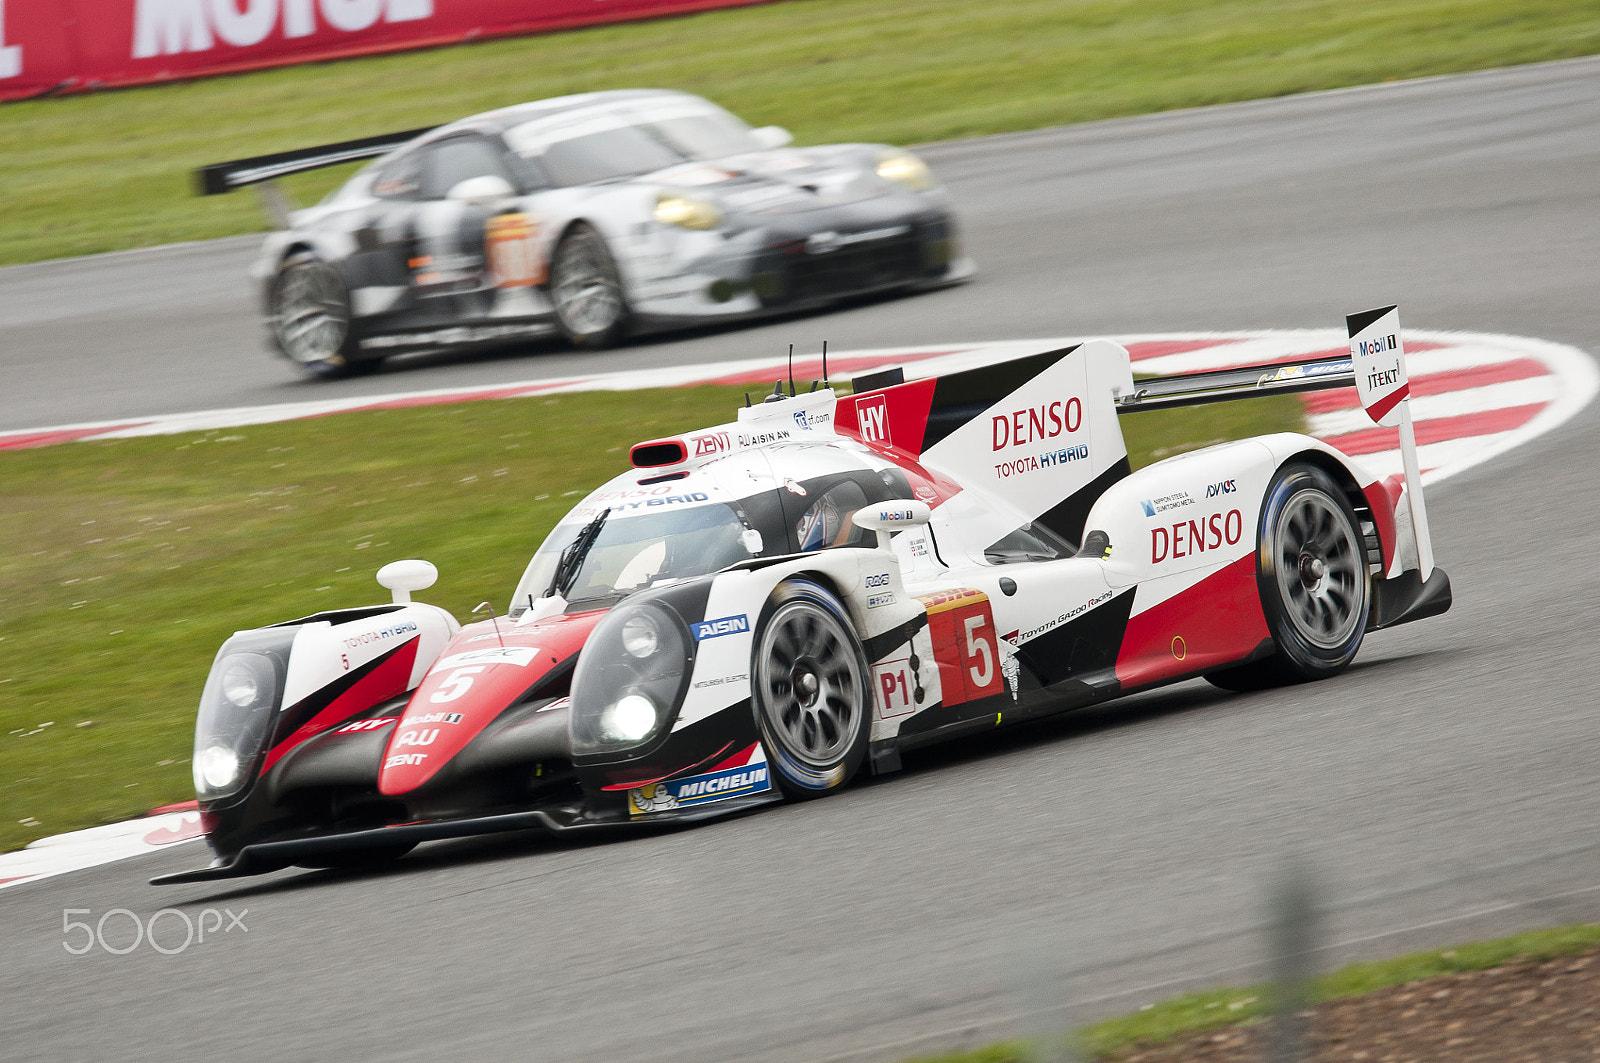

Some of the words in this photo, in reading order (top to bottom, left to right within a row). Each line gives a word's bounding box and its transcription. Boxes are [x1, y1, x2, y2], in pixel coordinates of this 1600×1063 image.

[1359, 336, 1387, 357] Mobil
[1388, 335, 1397, 350] 1
[1367, 368, 1397, 392] JTEKT
[859, 404, 885, 442] HY
[992, 397, 1082, 451] DENSO
[690, 432, 731, 458] ZENT
[752, 433, 775, 446] AISIN
[777, 430, 790, 440] AW
[995, 456, 1039, 479] TOYOTA
[1040, 444, 1089, 469] HYBRID
[585, 485, 672, 504] DENSO
[1181, 498, 1195, 507] METAL
[880, 511, 904, 521] Mobil
[1151, 509, 1242, 564] DENSO
[1020, 620, 1056, 641] TOYOTA
[1058, 604, 1087, 623] GAZOO
[1088, 590, 1113, 608] Racing
[699, 617, 746, 638] AISIN
[344, 632, 381, 649] TOYOTA
[964, 614, 993, 688] 5
[341, 653, 350, 670] 5
[429, 666, 486, 703] 5
[880, 668, 909, 709] P1
[338, 718, 395, 732] HY
[399, 712, 445, 728] Mobil
[384, 754, 428, 770] ZENT
[678, 768, 766, 798] MICHELIN
